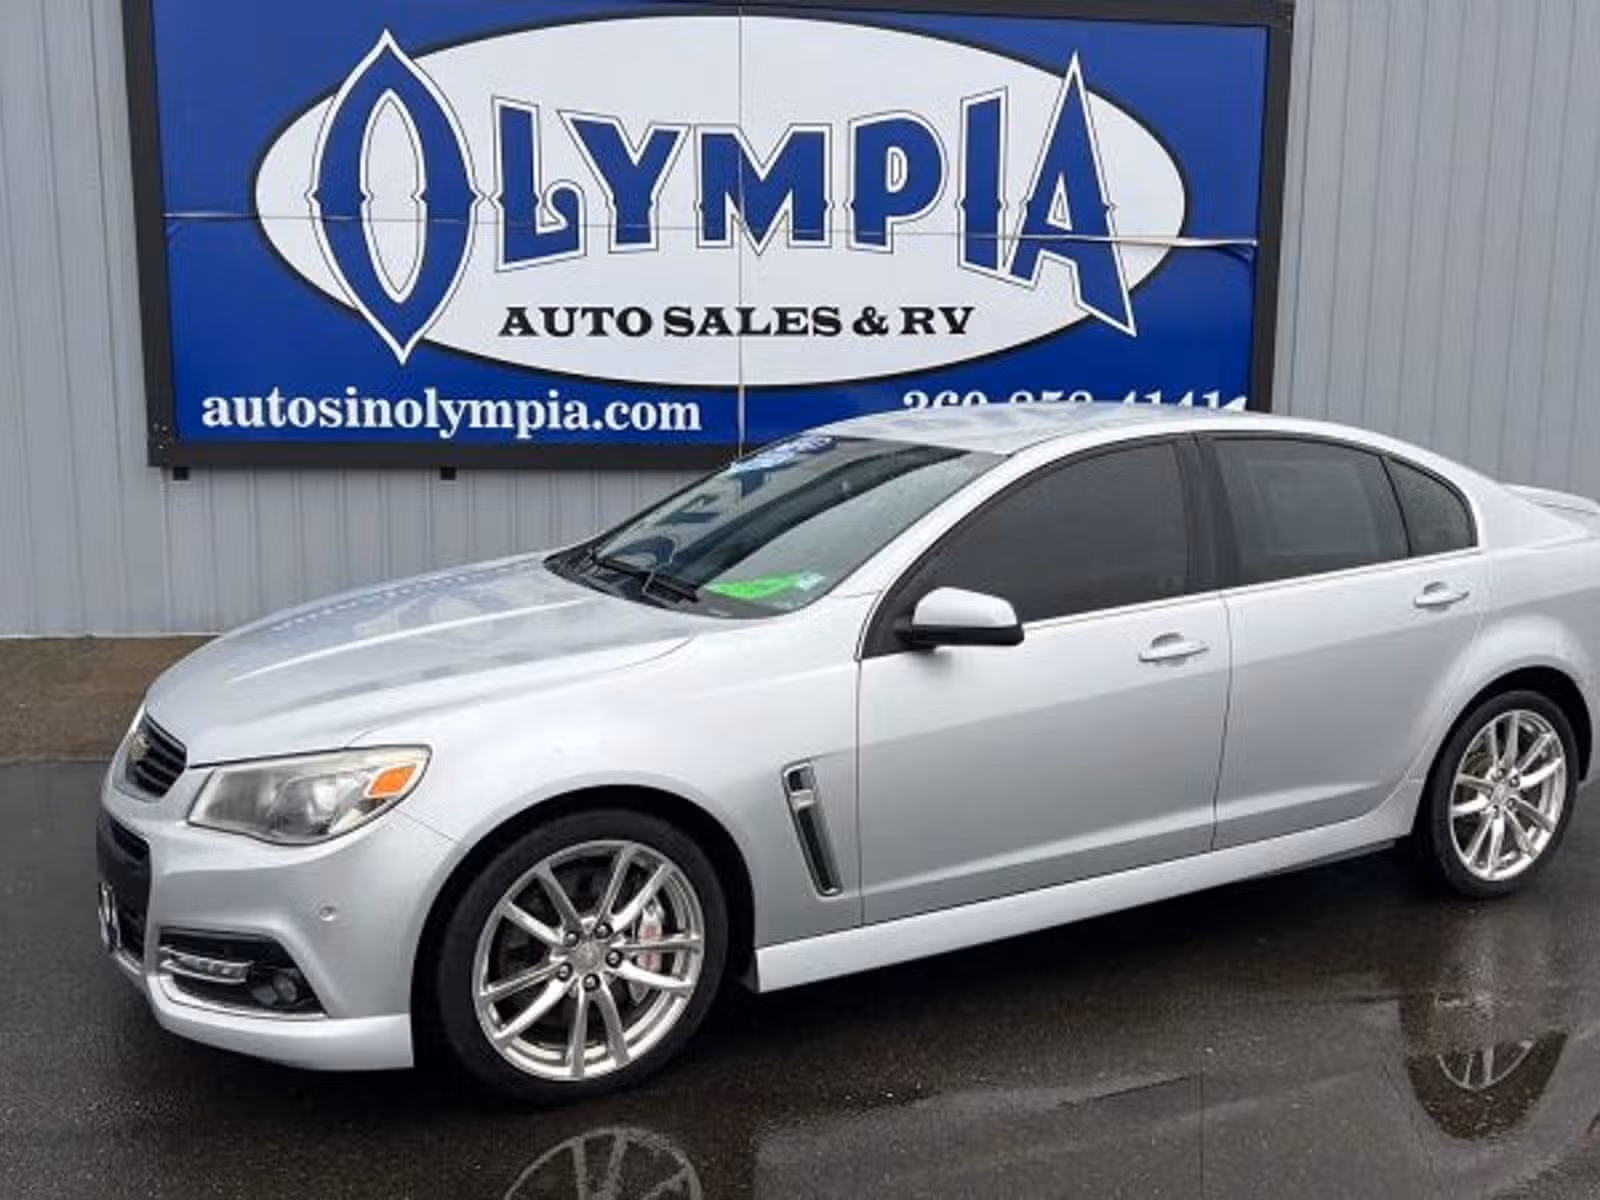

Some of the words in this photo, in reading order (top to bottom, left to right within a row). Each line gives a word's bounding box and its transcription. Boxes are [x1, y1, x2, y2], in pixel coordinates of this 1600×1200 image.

[307, 28, 1138, 365] OLYMPIA
[499, 306, 653, 337] AUTO
[663, 306, 842, 337] SALES
[852, 306, 889, 336] &
[899, 306, 976, 335] RV
[201, 386, 702, 439] autosinolympia.com
